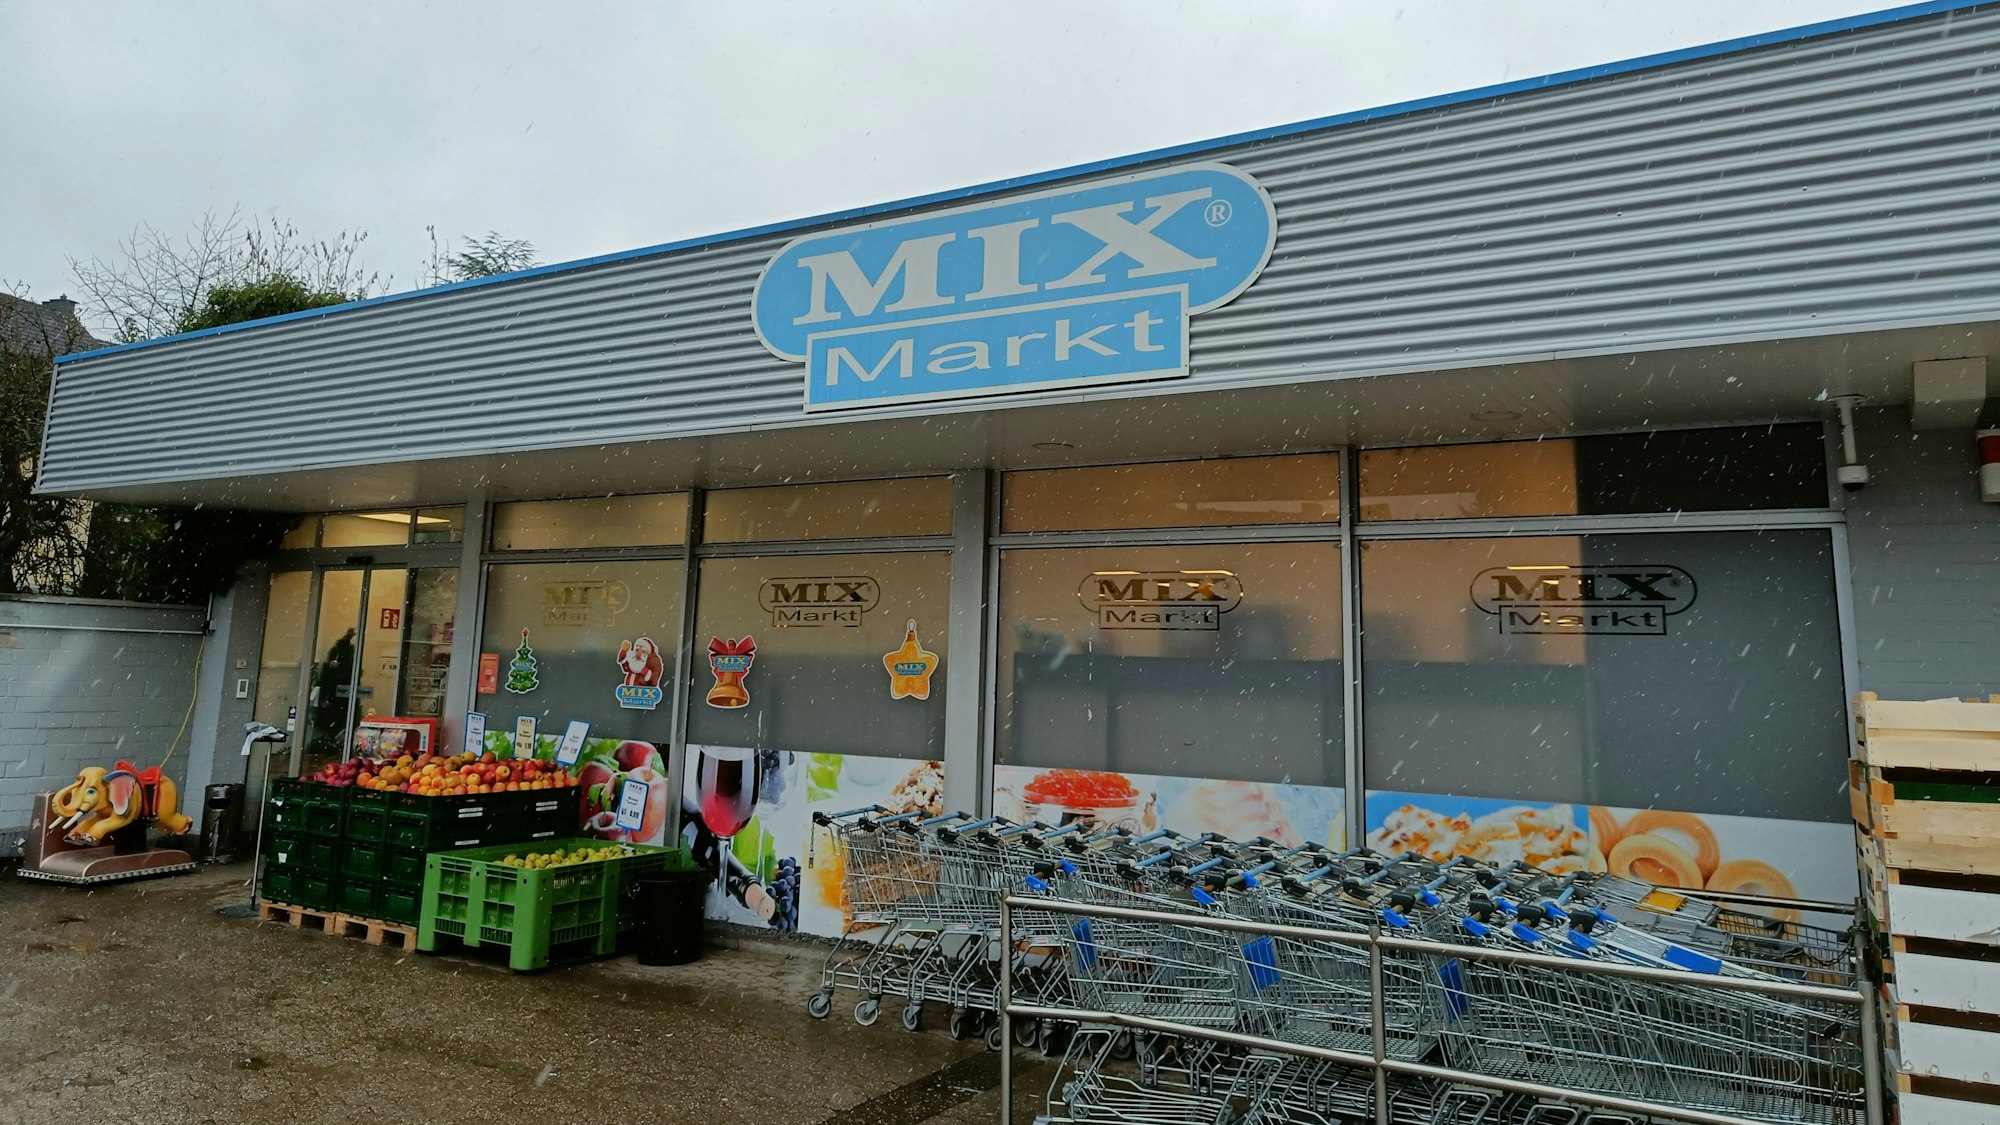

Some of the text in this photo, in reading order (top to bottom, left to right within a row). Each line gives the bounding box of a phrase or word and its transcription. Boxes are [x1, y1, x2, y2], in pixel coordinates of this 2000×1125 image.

[825, 309, 1166, 386] Markt
[769, 582, 869, 603] MIX
[1094, 578, 1228, 602] MIX
[1491, 573, 1676, 601] MIX
[777, 609, 858, 622] Markt
[1106, 610, 1215, 624] Markt
[1509, 611, 1657, 627] Markt
[715, 656, 749, 666] MIX
[896, 663, 926, 671] MIX
[621, 687, 657, 698] MIX
